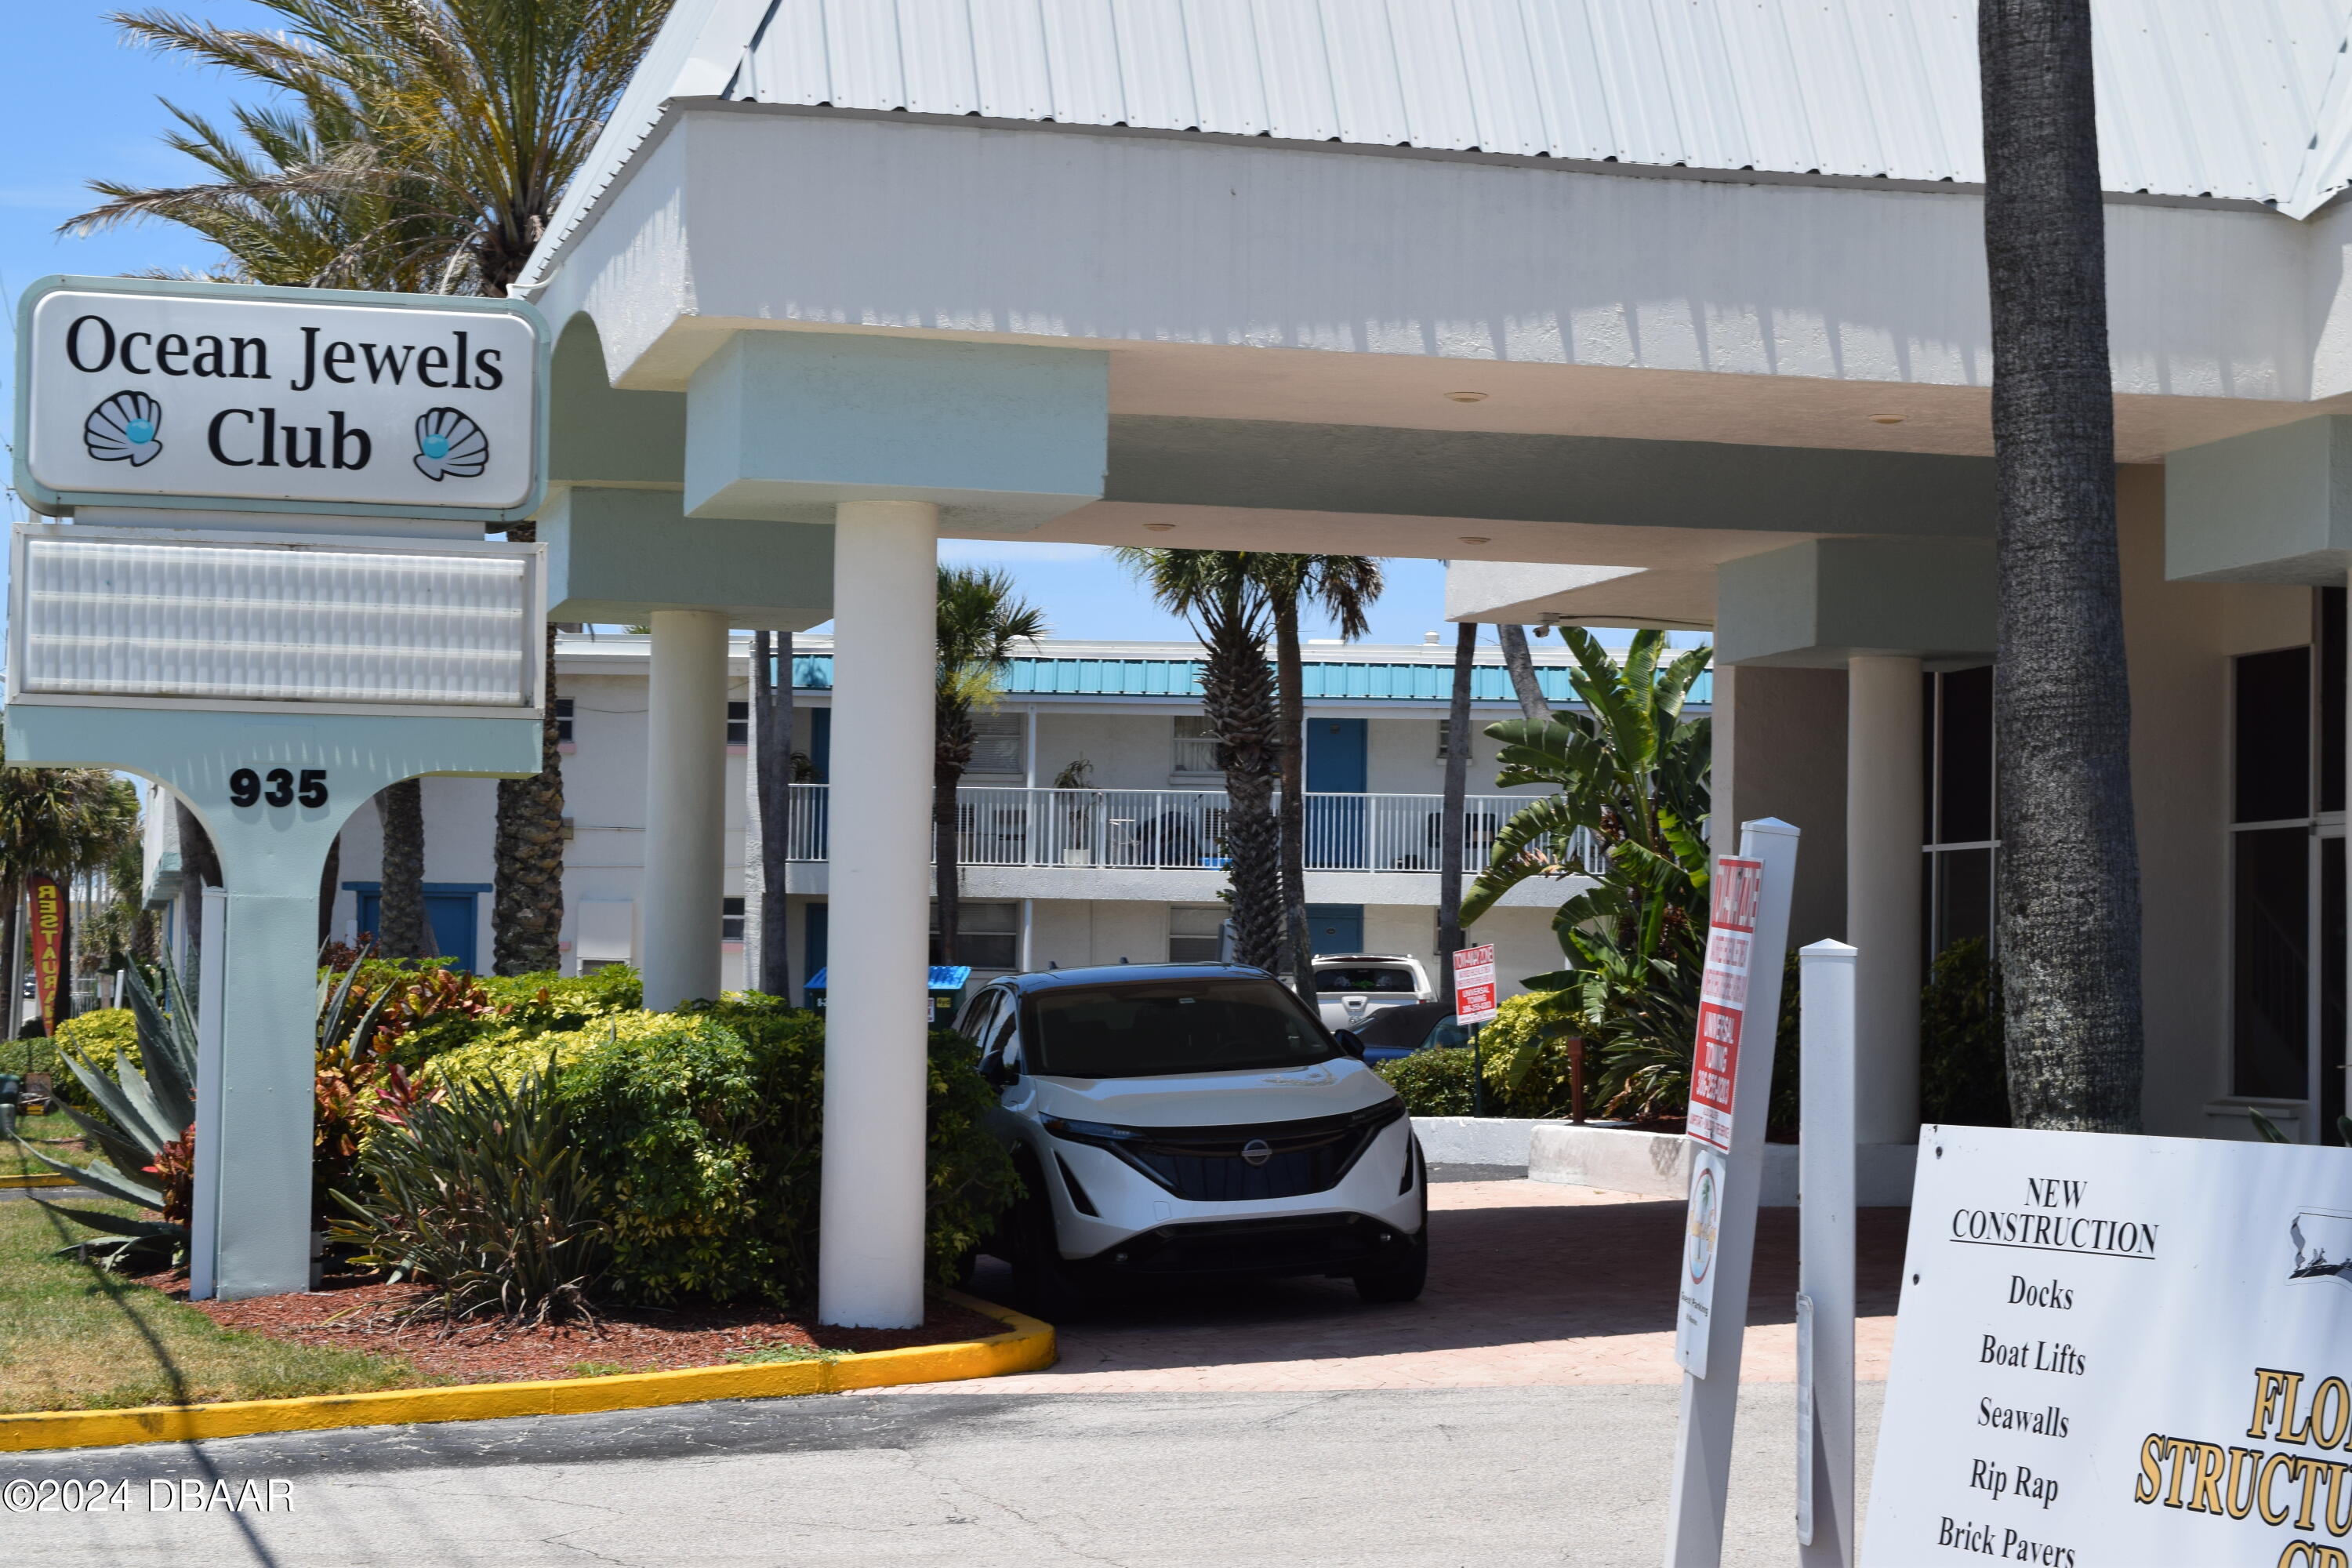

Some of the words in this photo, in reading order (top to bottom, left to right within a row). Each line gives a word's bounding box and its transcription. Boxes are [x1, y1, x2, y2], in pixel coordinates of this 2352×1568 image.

[67, 314, 271, 379] Ocean
[291, 326, 503, 391] Jewels
[208, 407, 371, 470] Club
[229, 768, 328, 808] 935
[2024, 1178, 2088, 1209] NEW
[1952, 1209, 2159, 1254] CONSTRUCTION
[2007, 1275, 2074, 1310] Docks
[1979, 1334, 2029, 1367] Boat
[2034, 1341, 2085, 1376] Lifts
[1977, 1397, 2070, 1438] Seawalls
[2246, 1367, 2352, 1451] FLO
[1969, 1458, 2007, 1501] Rip
[2013, 1465, 2059, 1510] Rap
[2135, 1433, 2352, 1537] STRUCTU
[1937, 1516, 1996, 1555] Brick
[2001, 1528, 2076, 1568] Pavers
